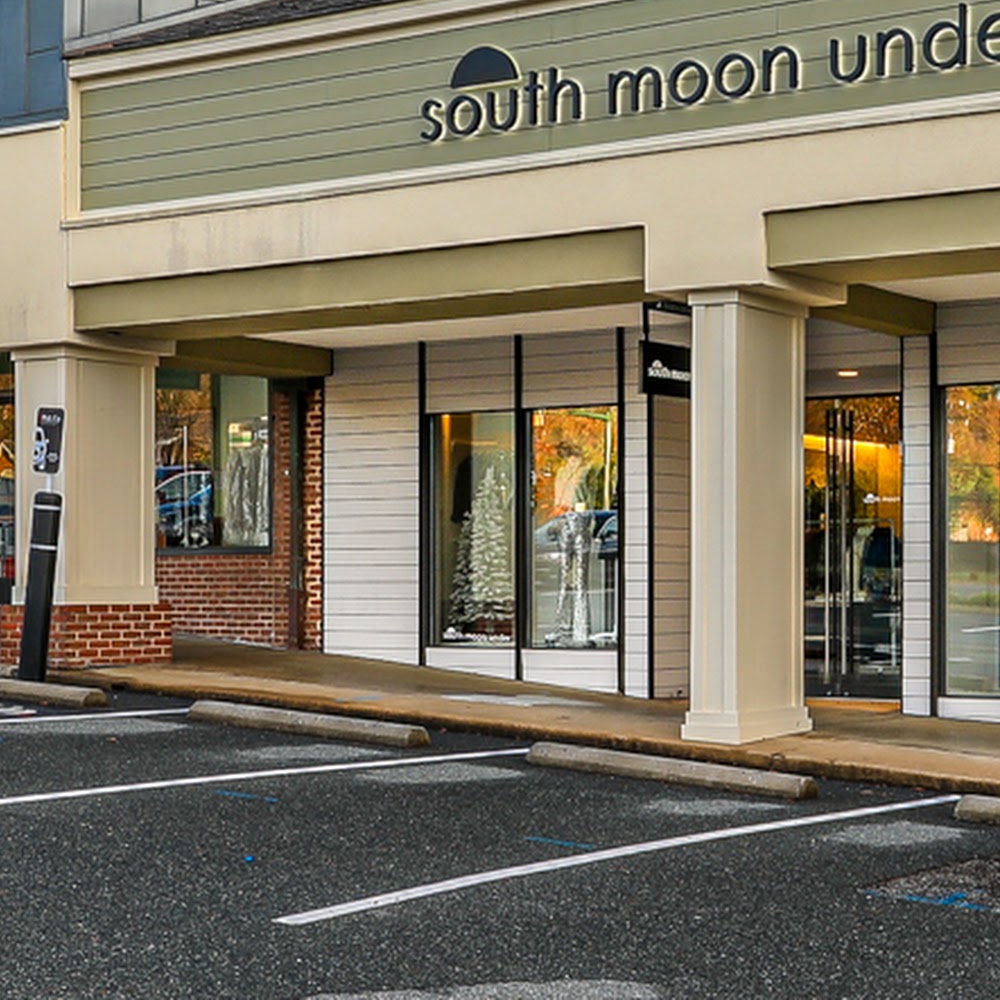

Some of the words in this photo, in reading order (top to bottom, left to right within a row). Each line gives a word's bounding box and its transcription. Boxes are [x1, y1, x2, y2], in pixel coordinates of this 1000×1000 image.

[420, 67, 583, 142] south
[608, 45, 800, 115] moon
[647, 366, 671, 379] south
